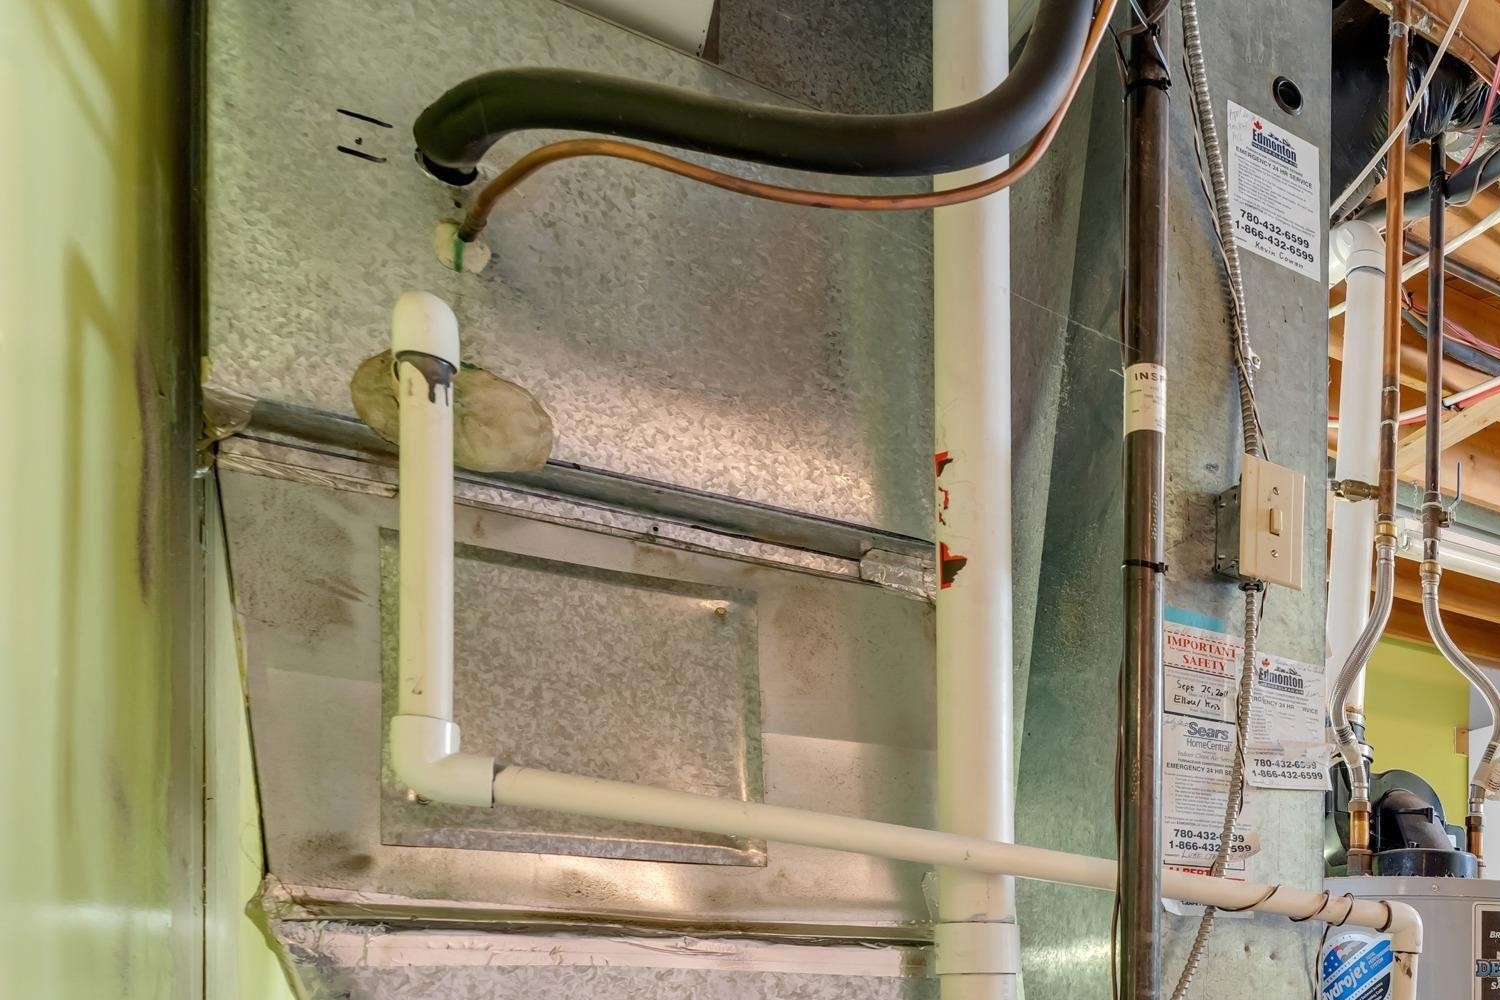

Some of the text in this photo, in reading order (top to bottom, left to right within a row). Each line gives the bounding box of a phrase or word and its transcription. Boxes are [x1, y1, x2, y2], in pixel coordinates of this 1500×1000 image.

[1252, 128, 1297, 162] Edmonton
[1235, 146, 1313, 189] EMERGENCY 24 HR SERVICE
[1240, 208, 1310, 249] 780-432-6599
[1235, 220, 1314, 263] 1-866-432-6599
[1255, 241, 1304, 269] Kevin Cowan
[614, 567, 892, 666] Goodman
[1168, 635, 1235, 658] IMPORTANT
[1183, 654, 1224, 671] SAFETY
[1177, 680, 1194, 692] Sept
[1258, 667, 1303, 689] Edmonton
[1187, 721, 1229, 740] Sears
[1187, 738, 1232, 752] HomeCentral
[1166, 762, 1205, 772] EMERGENCY
[1252, 769, 1323, 780] 1-866-432-6599
[1169, 840, 1252, 853] 1-866-432-599
